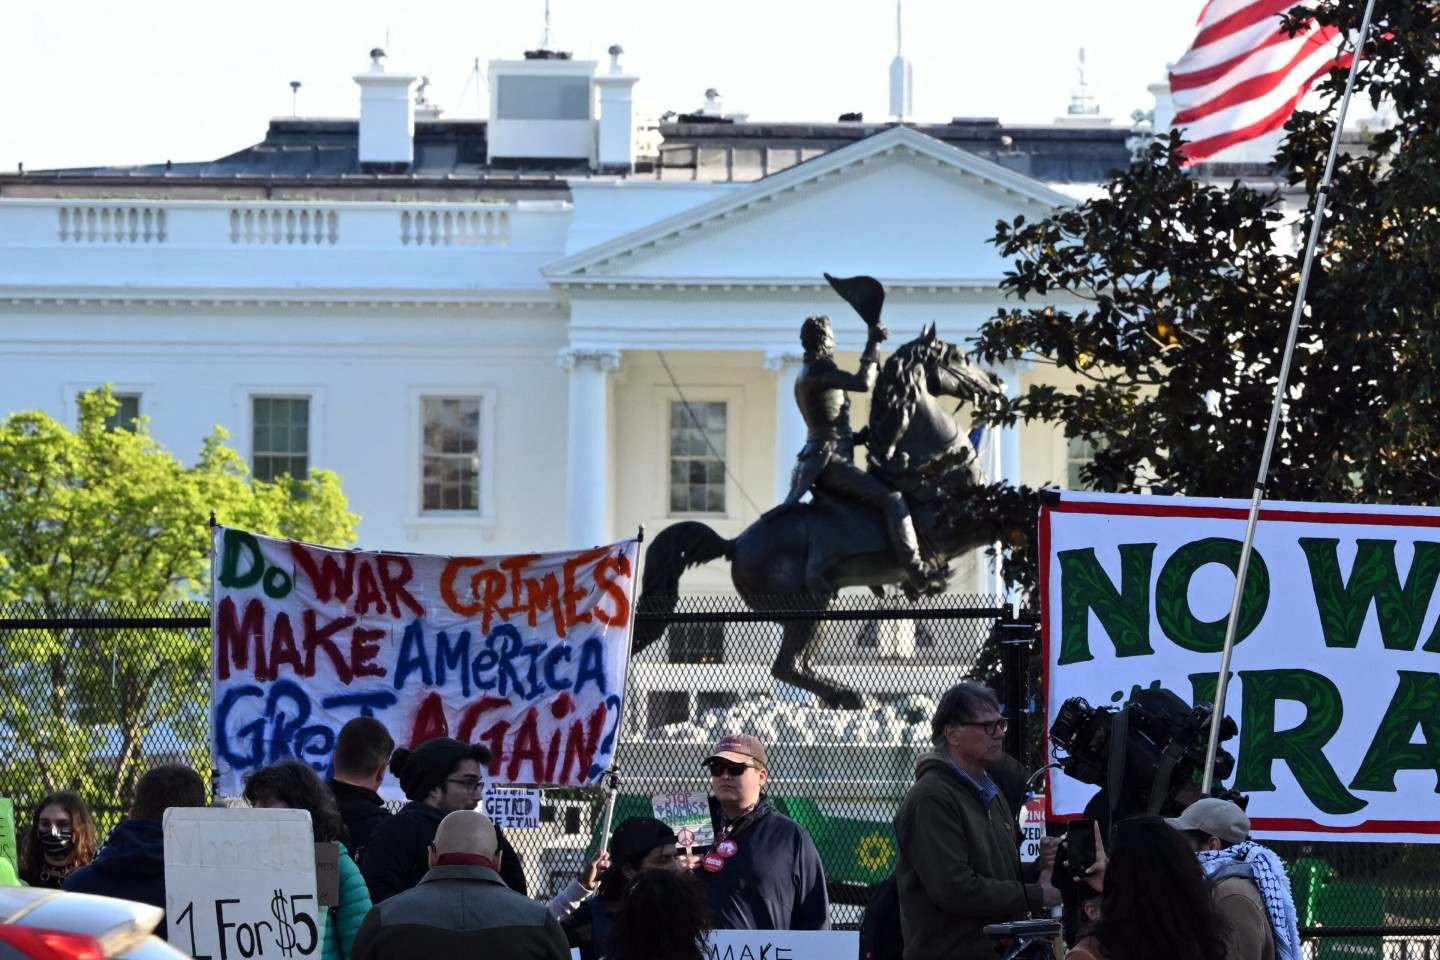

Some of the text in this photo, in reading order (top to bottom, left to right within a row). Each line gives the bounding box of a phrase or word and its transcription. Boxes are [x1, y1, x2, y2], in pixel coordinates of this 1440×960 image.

[218, 529, 631, 638] Do WAR CRIMES
[1057, 537, 1270, 665] NO
[217, 595, 387, 685] MAKE
[485, 797, 510, 815] GET
[665, 802, 698, 816] BOMBS
[666, 791, 691, 804] STOP
[176, 889, 318, 960] 1 For $5
